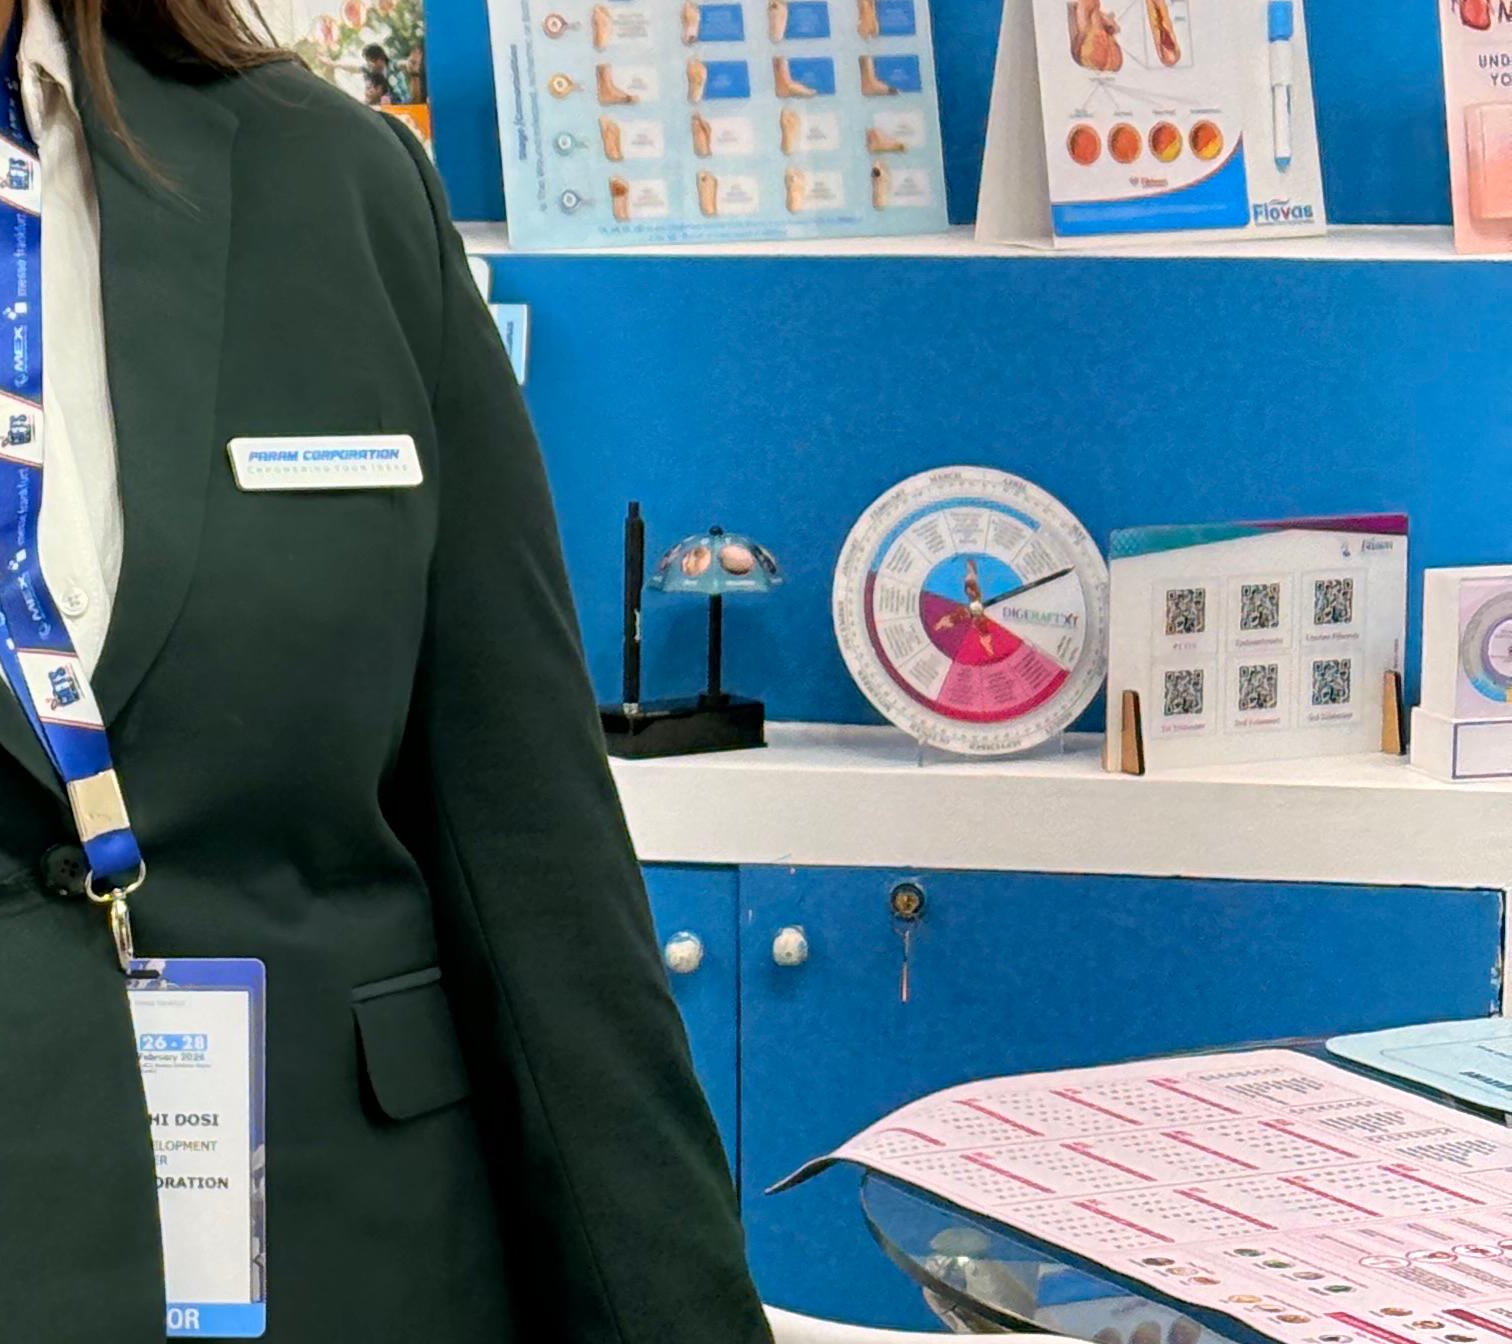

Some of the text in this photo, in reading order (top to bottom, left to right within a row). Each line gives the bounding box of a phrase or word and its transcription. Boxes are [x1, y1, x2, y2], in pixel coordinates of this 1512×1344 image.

[248, 448, 400, 462] PARAM CORPORATION
[142, 1034, 205, 1050] 26 28
[174, 1113, 219, 1127] DOSI
[167, 1306, 200, 1331] OR
